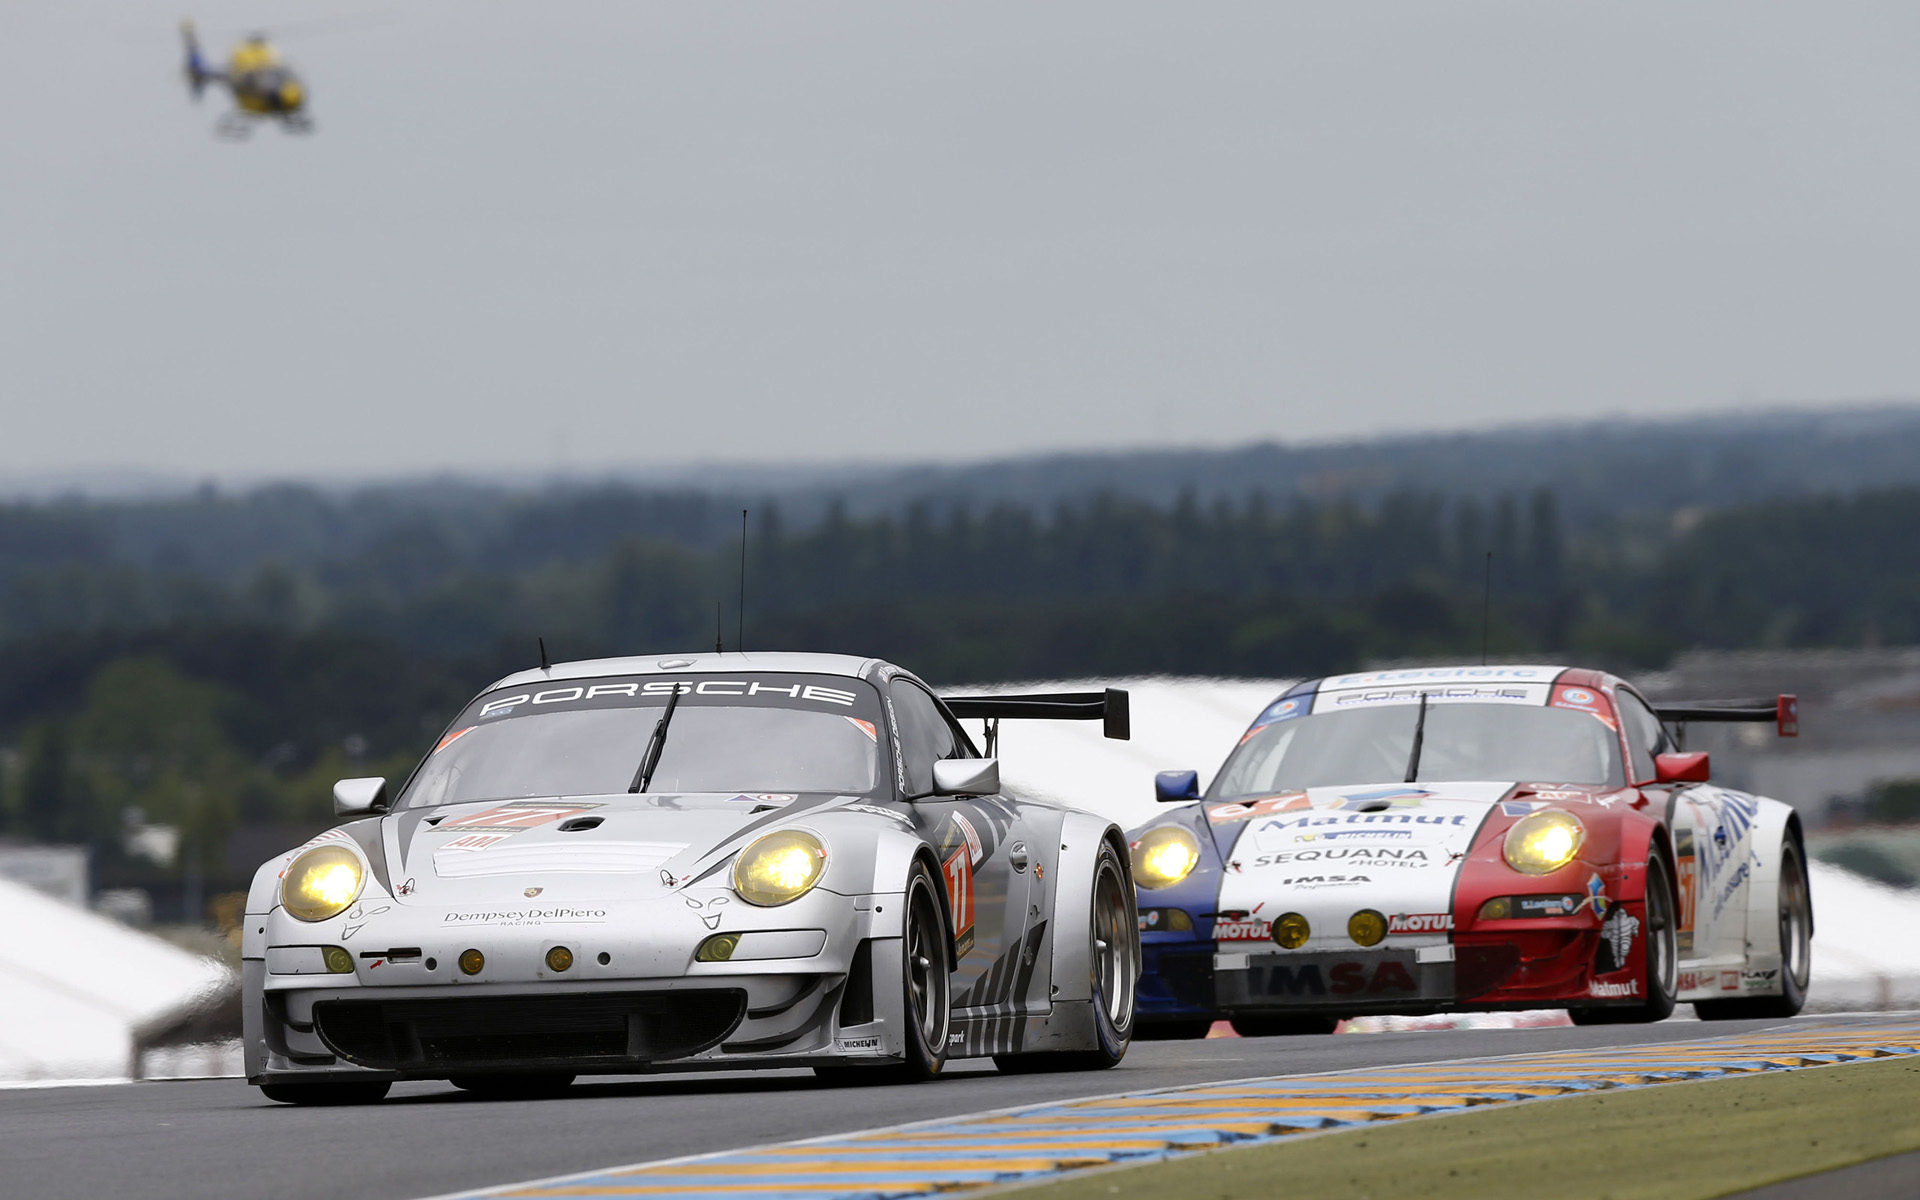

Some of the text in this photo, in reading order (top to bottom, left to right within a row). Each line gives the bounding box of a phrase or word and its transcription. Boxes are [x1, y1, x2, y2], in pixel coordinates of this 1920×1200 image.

[479, 680, 857, 717] PORSCHE
[1336, 688, 1527, 704] PORSCHE
[885, 695, 900, 737] DESIGN
[893, 737, 905, 795] PORSCHE
[1208, 794, 1305, 817] 67
[457, 808, 574, 826] 77
[1258, 812, 1468, 832] Matmut
[446, 835, 504, 848] AM
[1335, 831, 1412, 840] MICHELIN
[1254, 848, 1429, 867] SEQUANA
[1283, 875, 1372, 885] IMSA
[950, 851, 967, 935] 77
[444, 908, 606, 922] DempseyDelPiero
[1388, 914, 1456, 933] MOTUL
[1211, 921, 1272, 940] MOTUL
[1250, 961, 1418, 997] IMSA
[843, 1038, 878, 1048] MICHELIN
